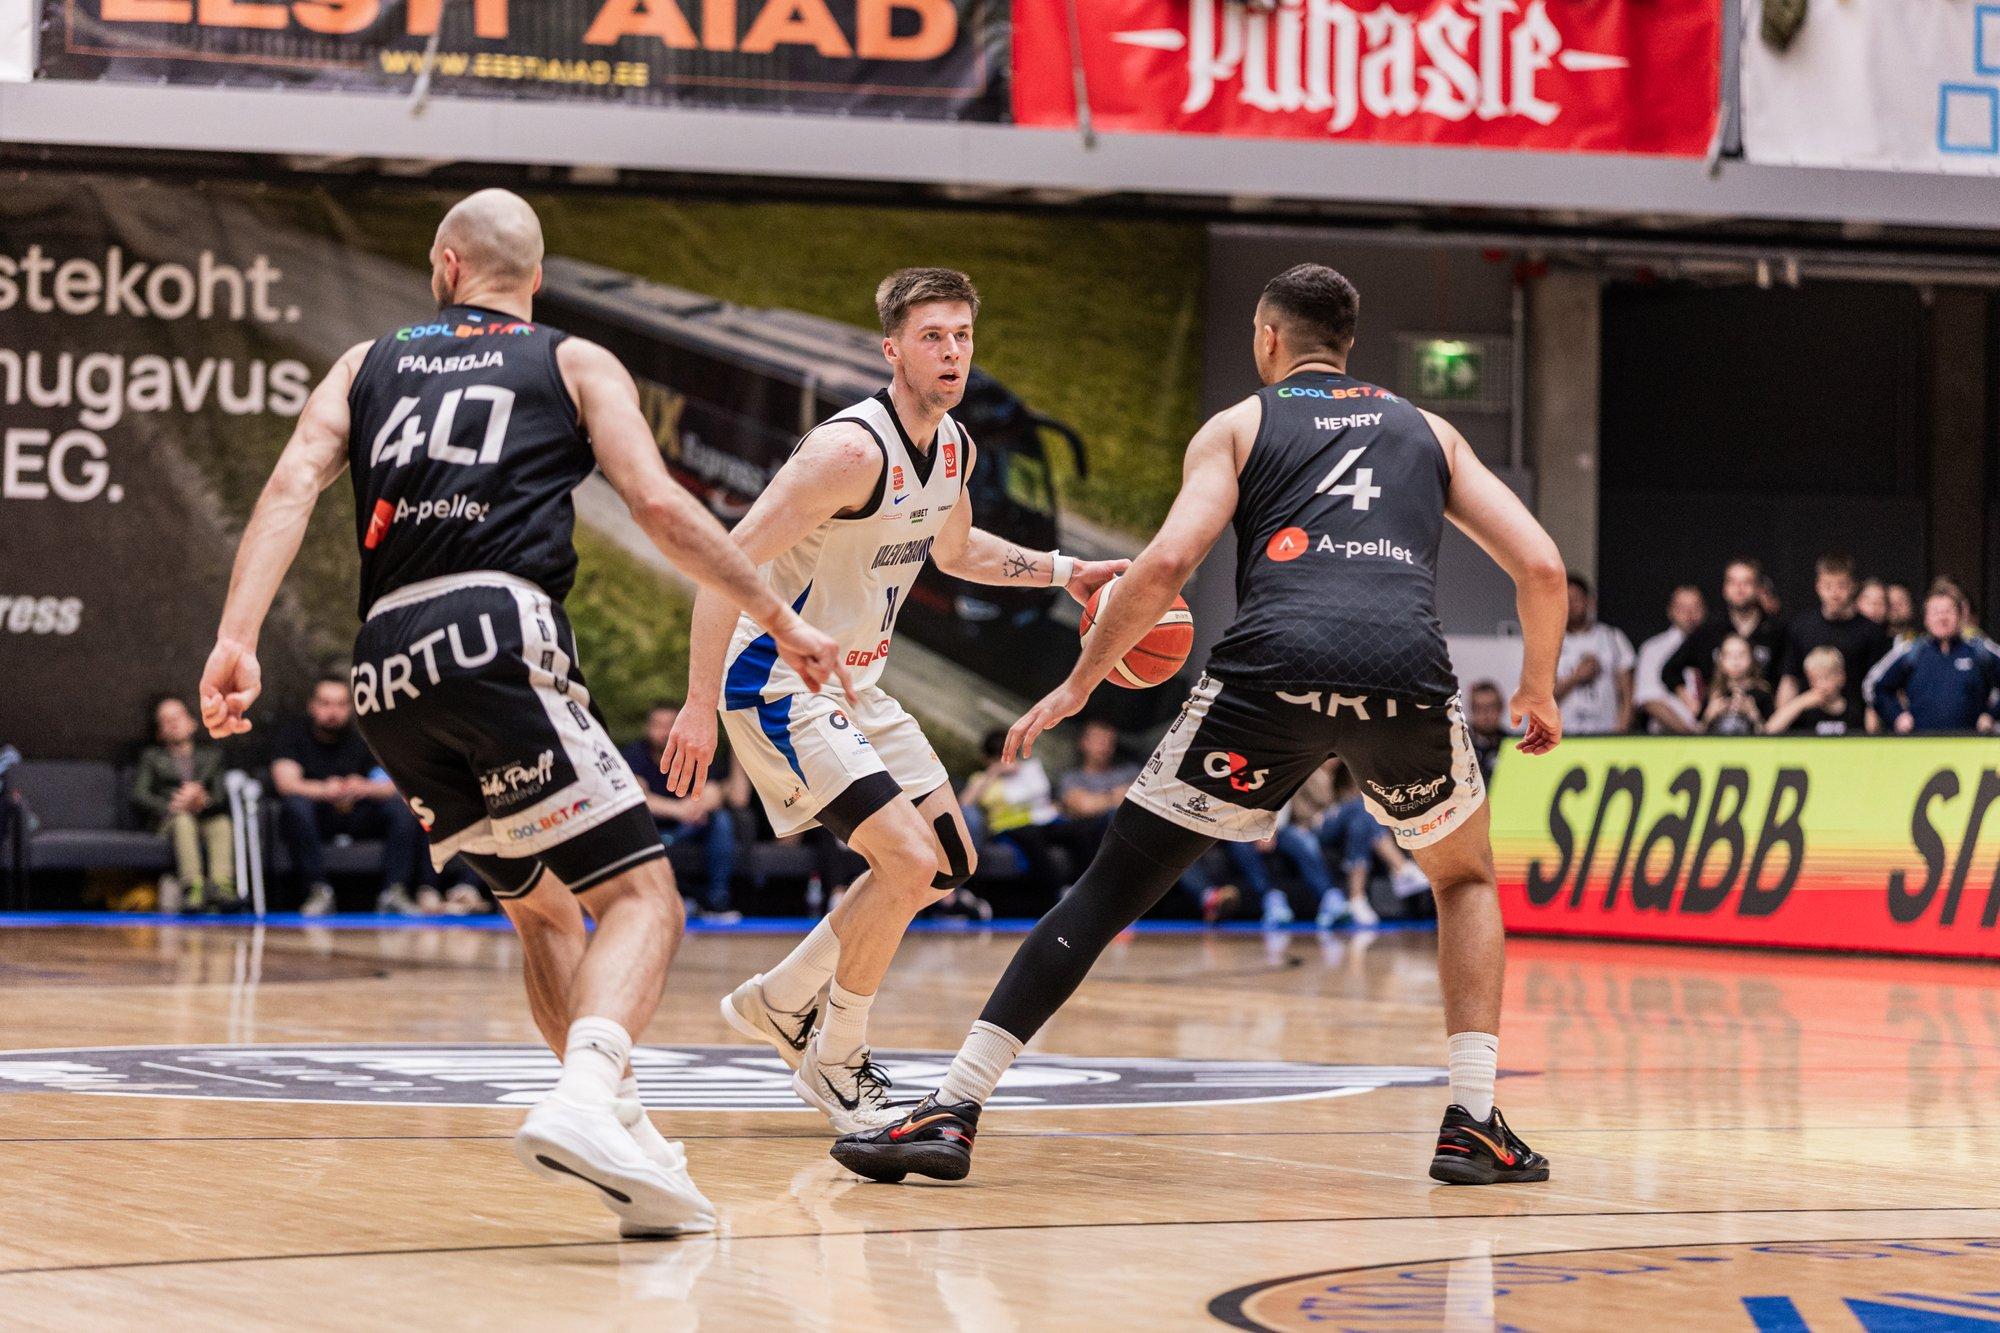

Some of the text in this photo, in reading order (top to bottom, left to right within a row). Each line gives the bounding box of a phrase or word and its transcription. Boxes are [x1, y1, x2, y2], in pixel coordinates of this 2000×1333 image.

[583, 0, 958, 61] AIAD
[1277, 386, 1372, 400] COOLBET
[370, 384, 516, 468] 40
[1314, 412, 1383, 430] HENRY
[1315, 446, 1382, 511] 4
[393, 493, 489, 526] A-pellet
[1316, 534, 1414, 565] A-pellet
[846, 640, 890, 667] CRO
[1394, 814, 1443, 837] OOLBET
